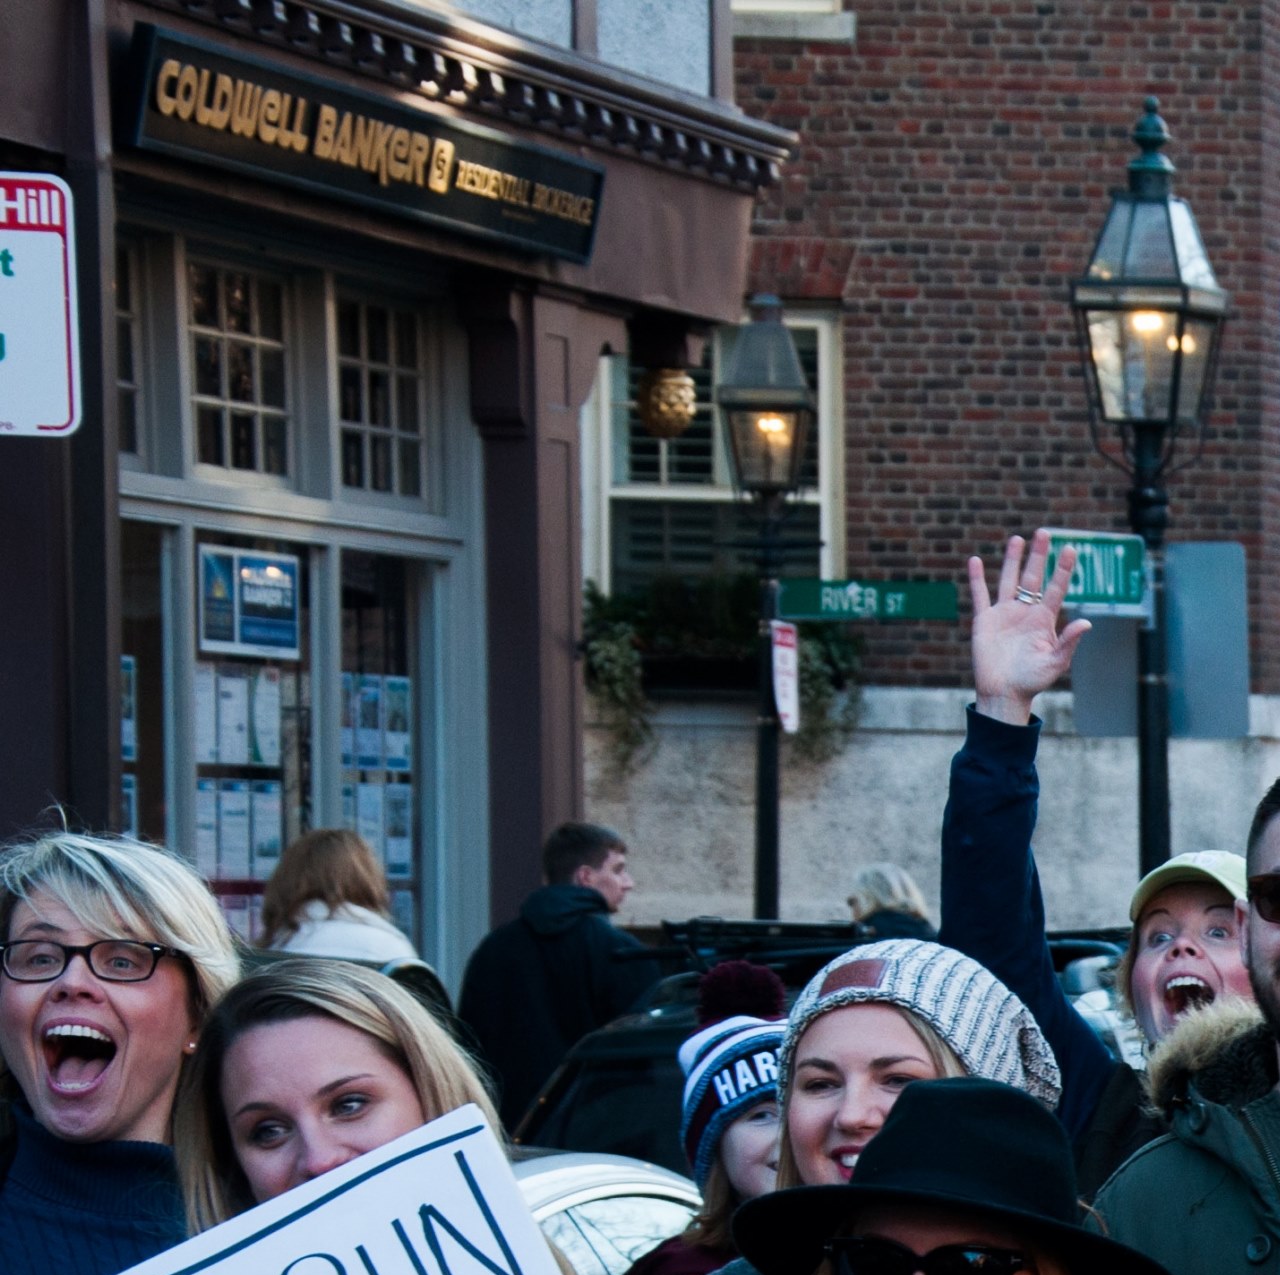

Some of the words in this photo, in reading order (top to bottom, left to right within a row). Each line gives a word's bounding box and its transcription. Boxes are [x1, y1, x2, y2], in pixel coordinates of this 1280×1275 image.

[821, 586, 877, 613] RIVER
[885, 592, 904, 614] ST
[713, 1048, 781, 1105] HAR
